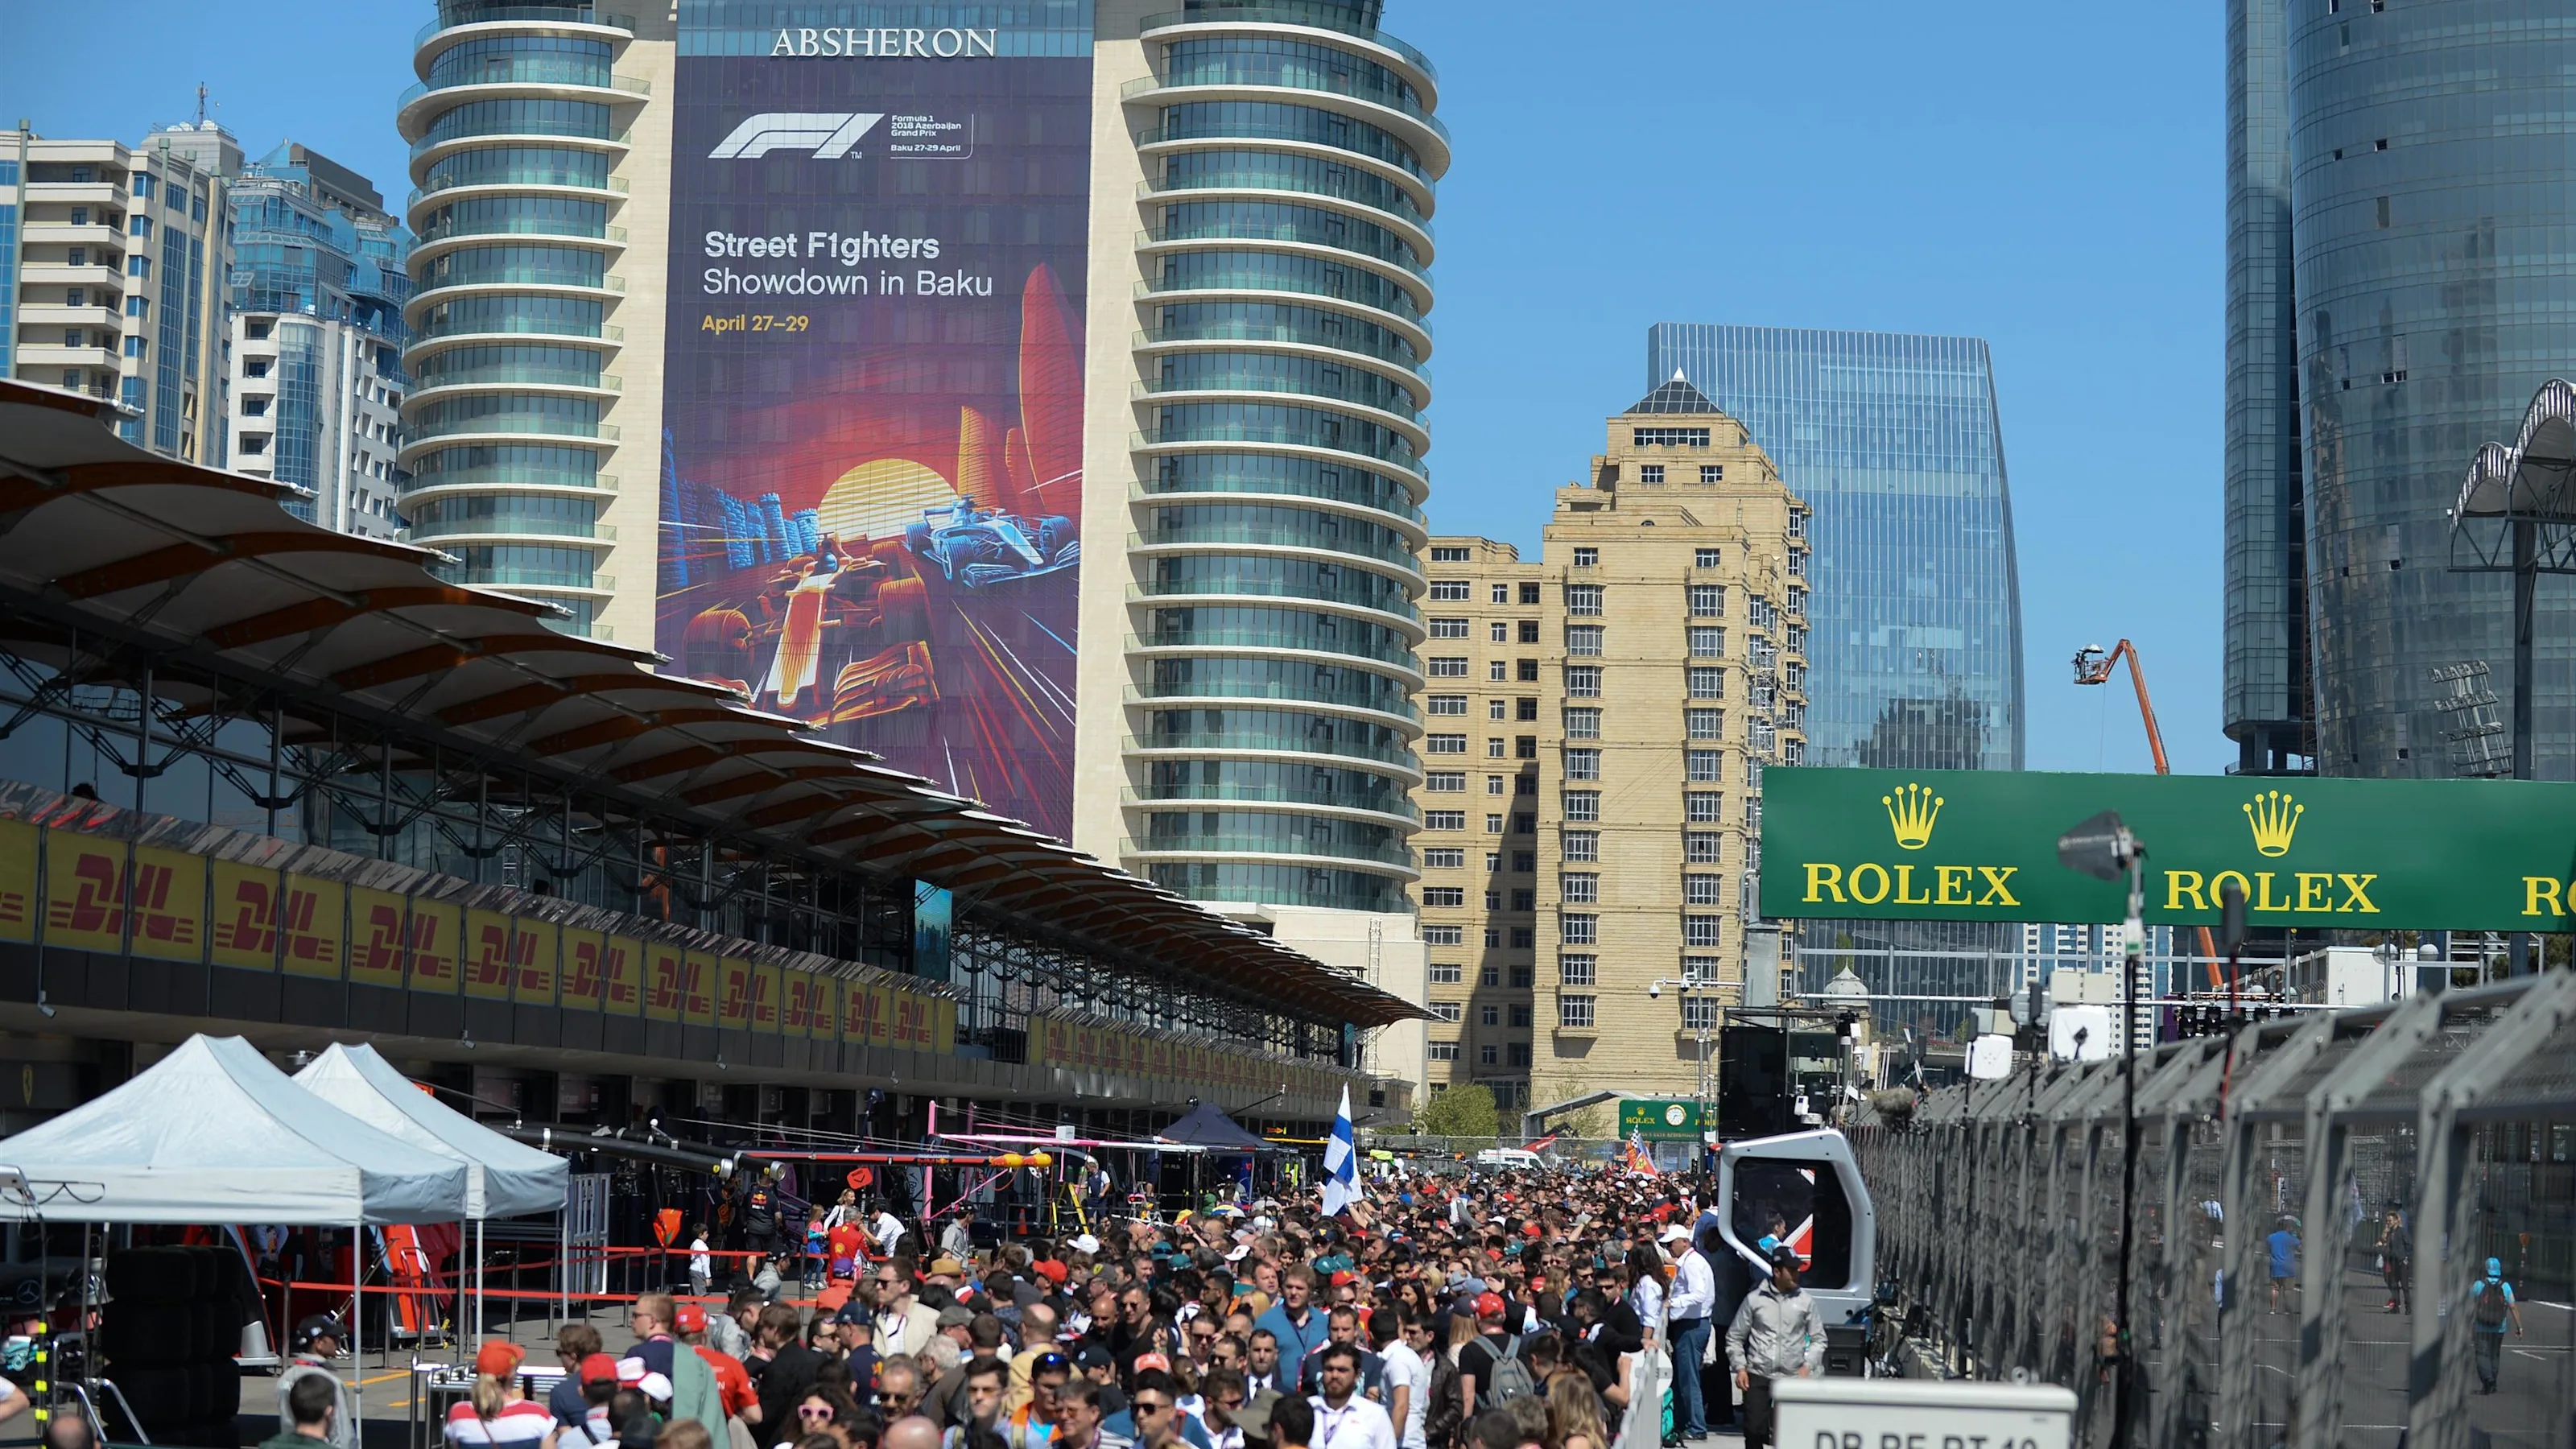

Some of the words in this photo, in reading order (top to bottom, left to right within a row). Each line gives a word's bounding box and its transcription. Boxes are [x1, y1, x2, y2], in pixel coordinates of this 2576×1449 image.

[770, 27, 997, 58] ABSHERON
[914, 122, 962, 131] Azerbaijan
[939, 145, 961, 153] April
[704, 231, 797, 258] Street
[808, 231, 939, 266] F1ghters
[703, 267, 868, 295] Showdown
[880, 270, 904, 295] in
[917, 269, 993, 296] Baku
[701, 314, 745, 335] April
[70, 853, 174, 942] DHL
[1802, 863, 2021, 906] ROLEX
[2164, 870, 2380, 913] ROLEX
[232, 880, 319, 960] DHL
[366, 905, 439, 976] DHL
[477, 925, 538, 990] DHL
[573, 941, 626, 1003] DHL
[656, 956, 702, 1013] DHL
[728, 970, 768, 1022] DHL
[789, 980, 825, 1029] DHL
[850, 990, 882, 1036] DHL
[899, 1000, 927, 1042] DHL
[1626, 1117, 1655, 1125] ROLEX
